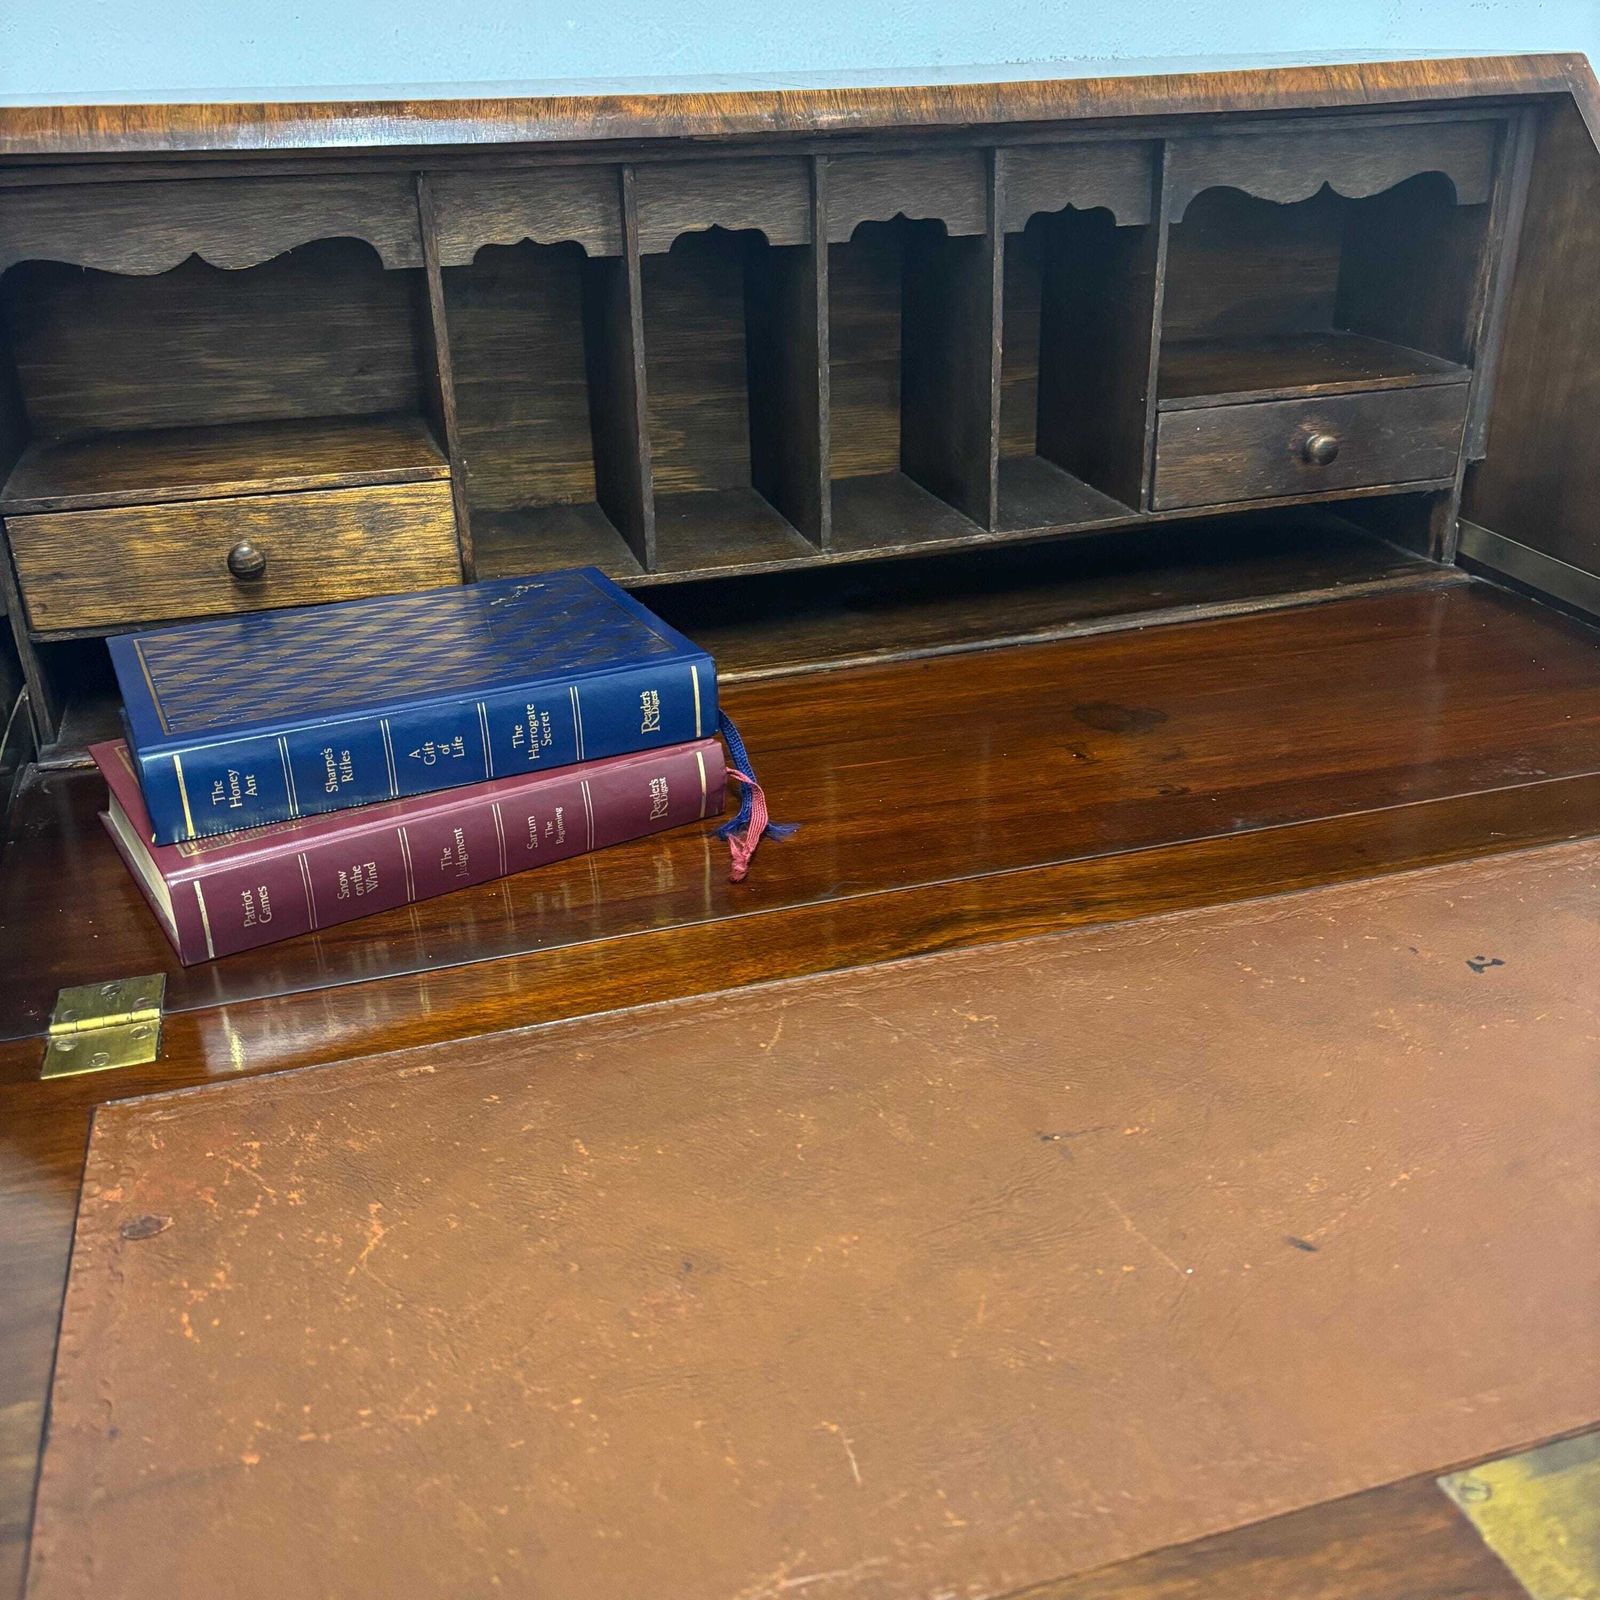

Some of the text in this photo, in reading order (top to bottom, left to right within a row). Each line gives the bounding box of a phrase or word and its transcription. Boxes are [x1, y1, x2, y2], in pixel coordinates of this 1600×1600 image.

[640, 690, 660, 735] Reader's
[651, 690, 660, 719] Digest
[512, 724, 525, 748] The
[527, 703, 540, 760] Harrogate
[540, 711, 553, 746] Secret
[409, 748, 421, 759] A
[422, 741, 436, 766] Gift
[437, 743, 450, 755] of
[451, 735, 465, 758] Life
[340, 750, 354, 783] Rifles
[212, 780, 225, 805] The
[229, 768, 242, 808] Honey
[245, 774, 258, 797] Ant
[649, 778, 668, 821] Reader's
[660, 777, 669, 803] Digest
[527, 815, 538, 850] Sarum
[545, 820, 554, 838] The
[556, 806, 565, 846] Beginning
[441, 847, 453, 871] The
[337, 870, 350, 899] Snow
[363, 861, 378, 893] Wind
[242, 890, 257, 928] Patriot
[258, 885, 272, 924] Games
